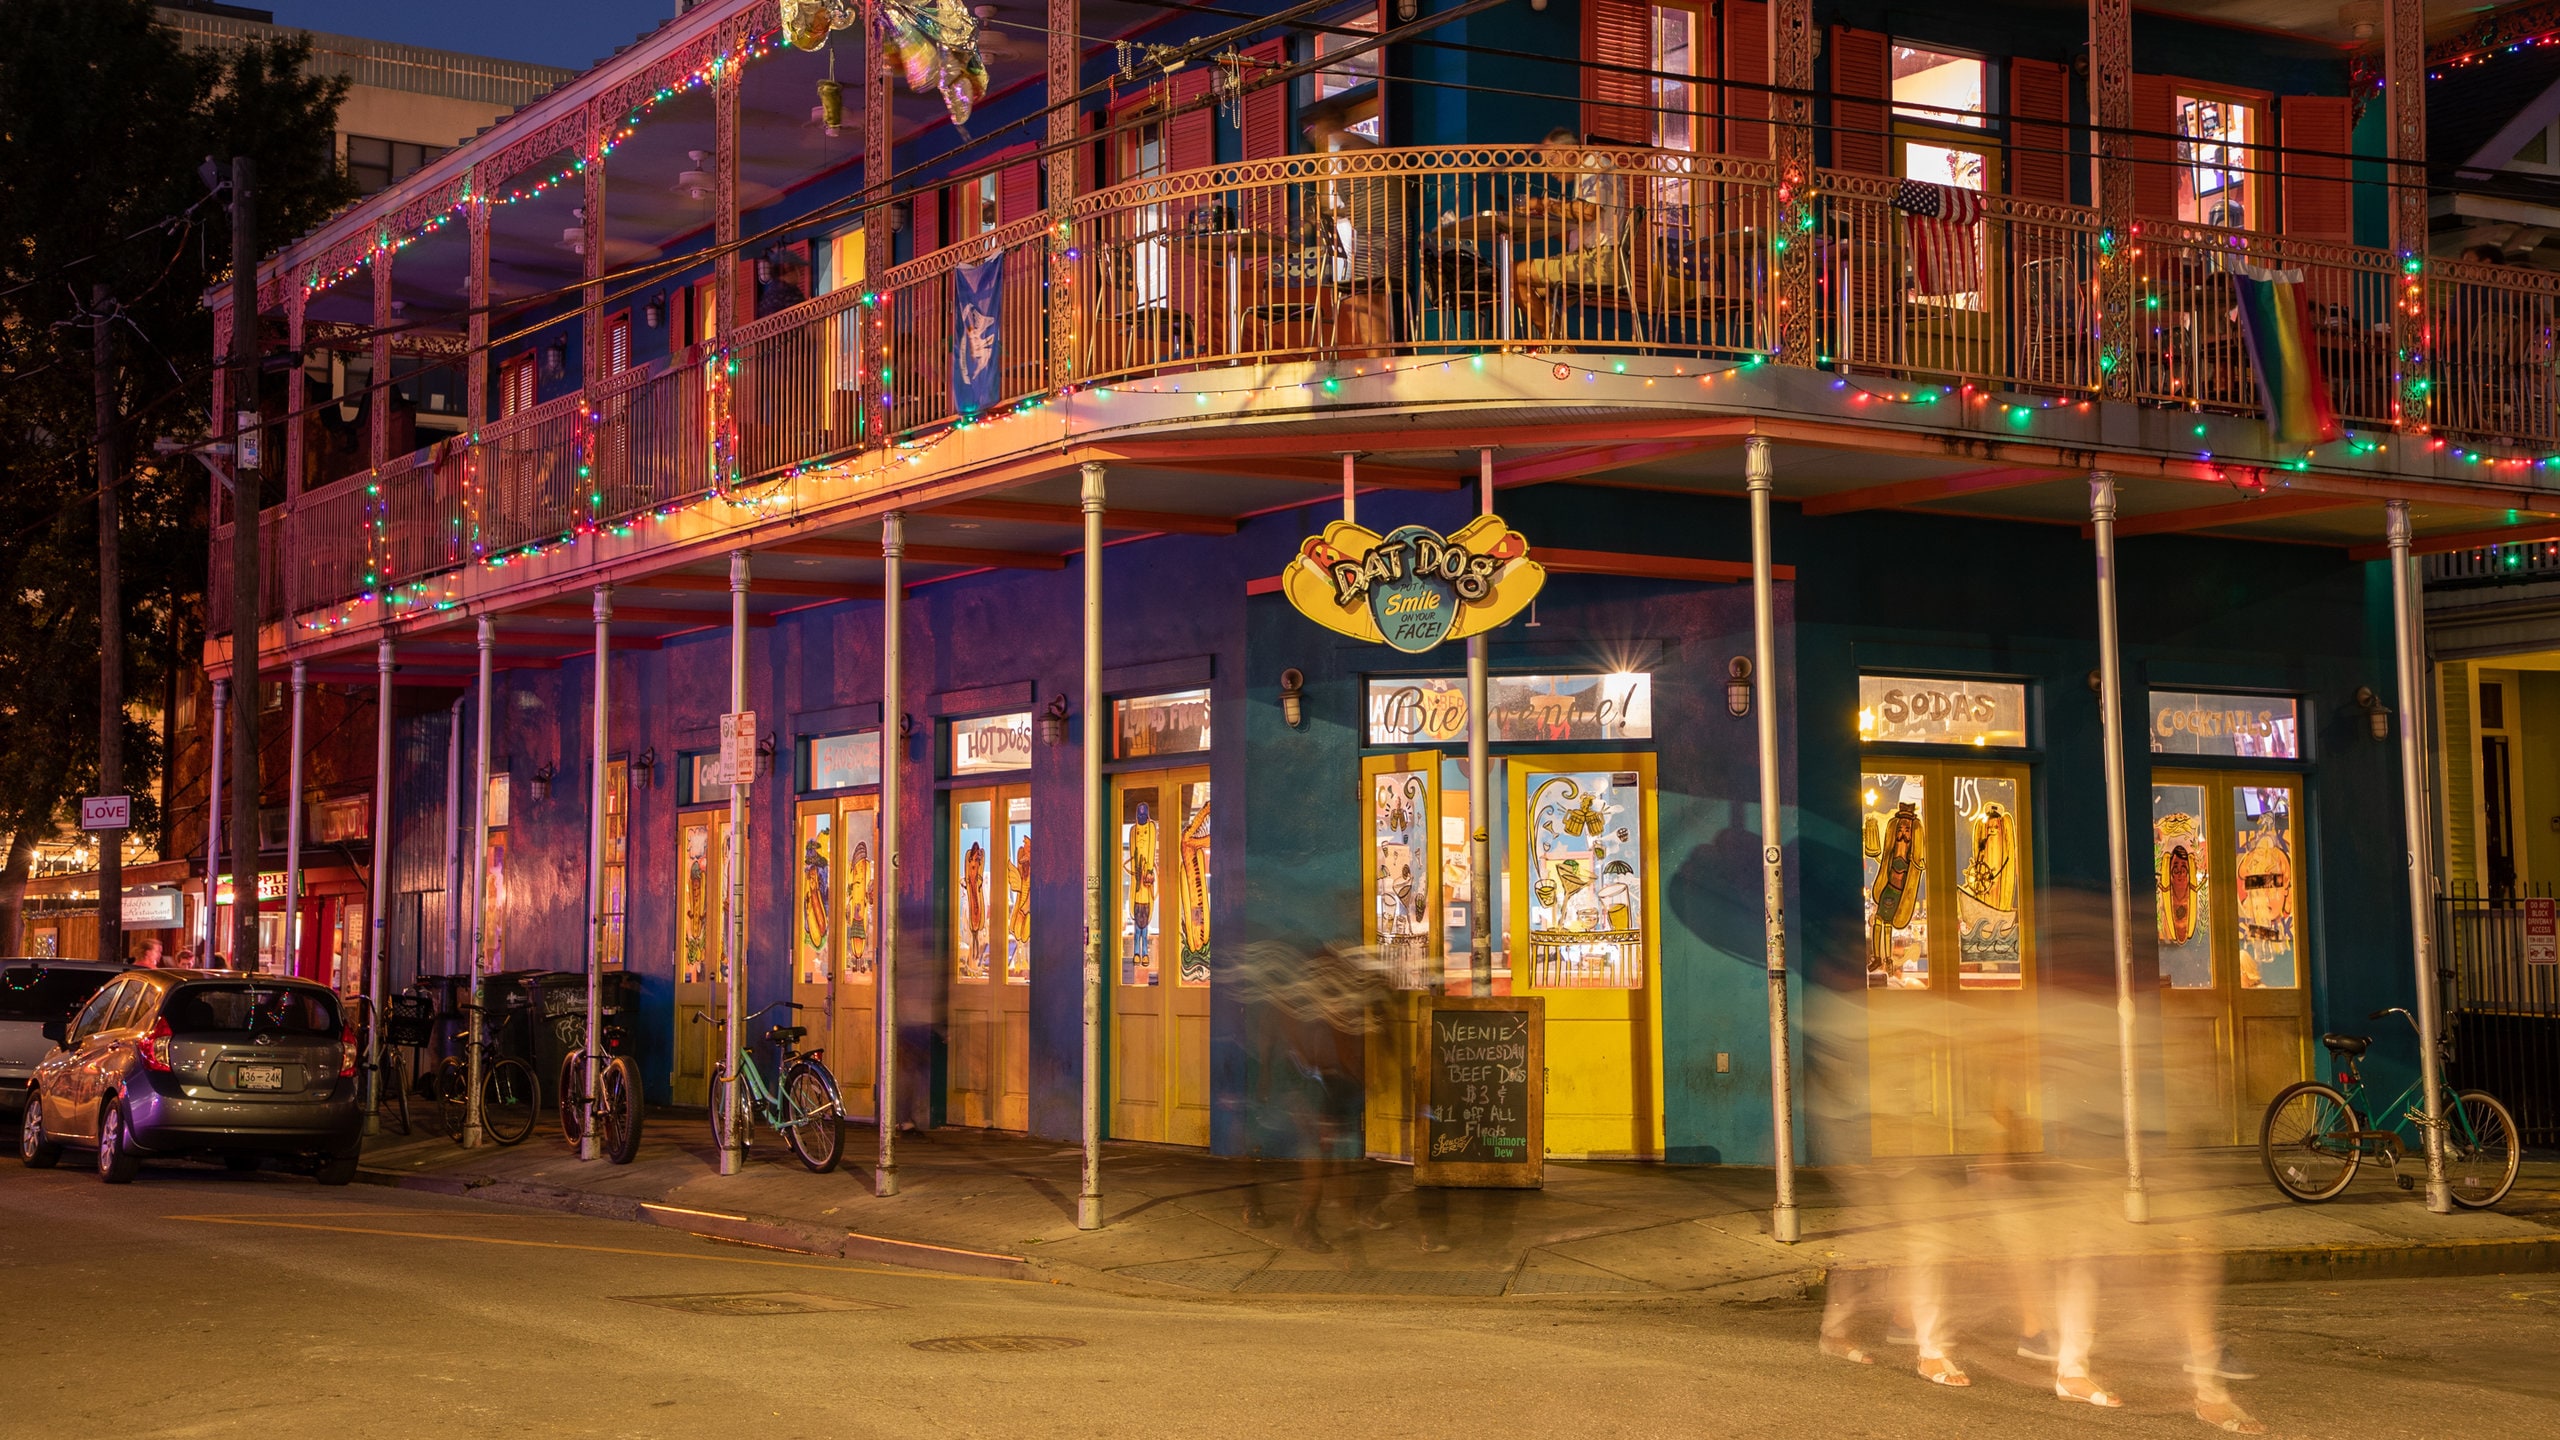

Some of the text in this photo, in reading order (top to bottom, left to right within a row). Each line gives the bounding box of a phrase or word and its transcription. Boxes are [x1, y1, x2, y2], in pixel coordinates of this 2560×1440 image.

[1332, 540, 1406, 605] DAT
[1400, 582, 1418, 592] PUT
[1384, 589, 1441, 616] Smile
[1400, 611, 1436, 622] ON YOUR
[1395, 621, 1442, 640] FACE!
[86, 806, 125, 819] LOVE
[1437, 1018, 1511, 1043] WEENIE
[1440, 1044, 1525, 1065] WEDNESDAY
[1448, 1064, 1491, 1083] BEEF
[1494, 1146, 1514, 1157] Dew
